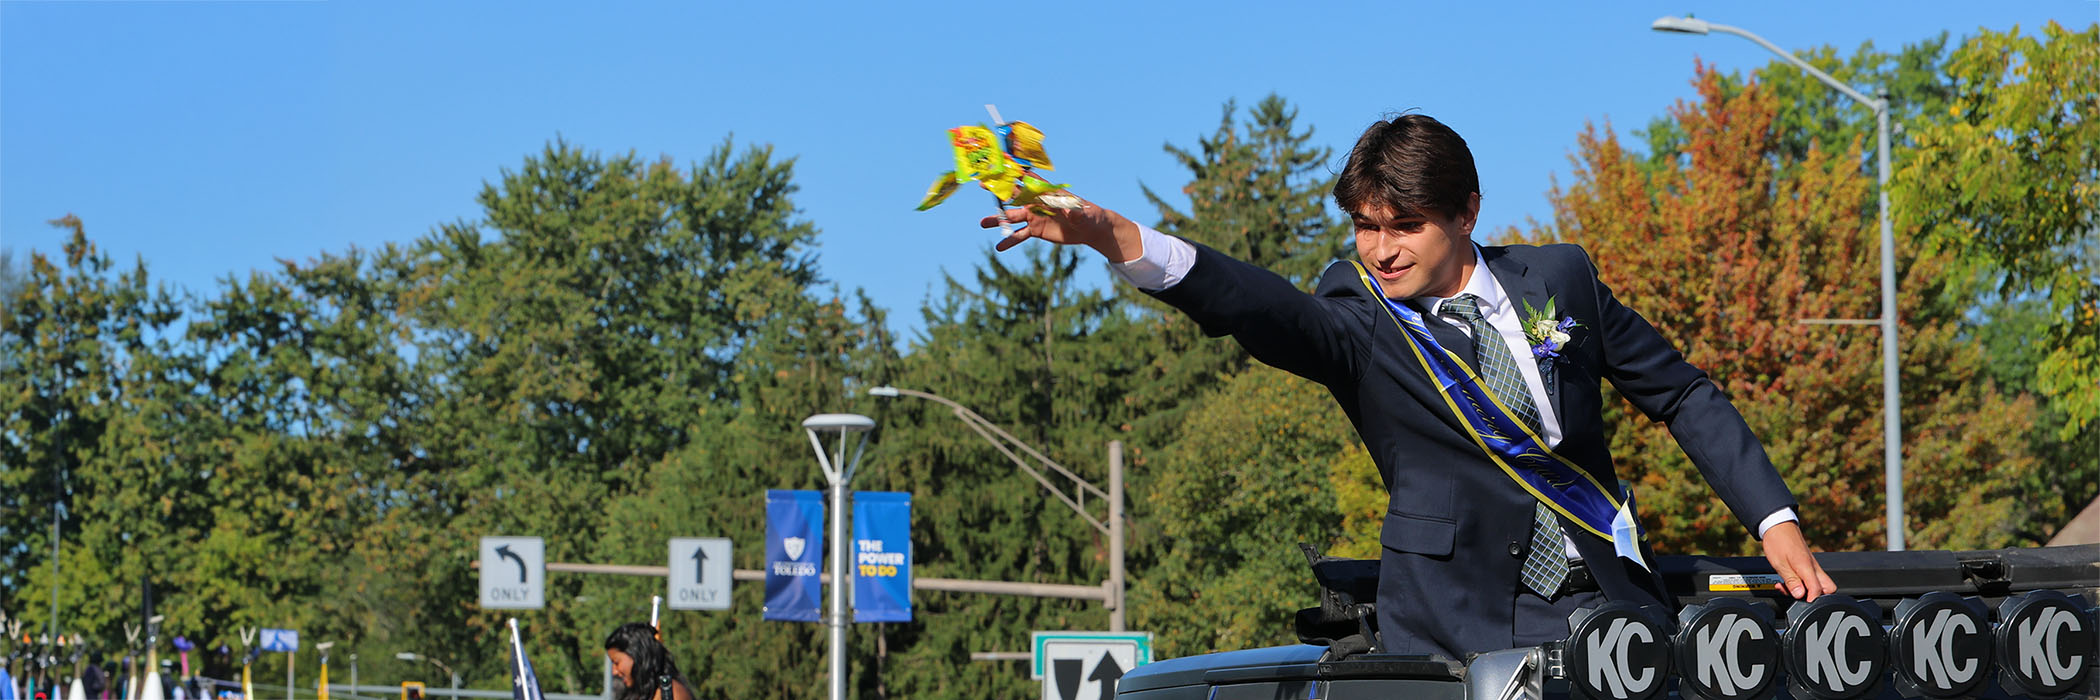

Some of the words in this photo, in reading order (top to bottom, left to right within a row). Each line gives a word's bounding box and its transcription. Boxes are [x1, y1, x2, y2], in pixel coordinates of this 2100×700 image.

[858, 539, 883, 552] THE
[858, 552, 905, 565] POWER
[774, 566, 816, 576] TOLEDO
[859, 565, 876, 577] TO
[877, 565, 898, 577] DO
[491, 587, 529, 600] ONLY
[679, 588, 718, 600] ONLY
[1805, 610, 1873, 692] KC
[1913, 608, 1978, 689] KC
[2019, 606, 2082, 687] KC
[1587, 617, 1656, 698] KC
[1697, 613, 1766, 696] KC
